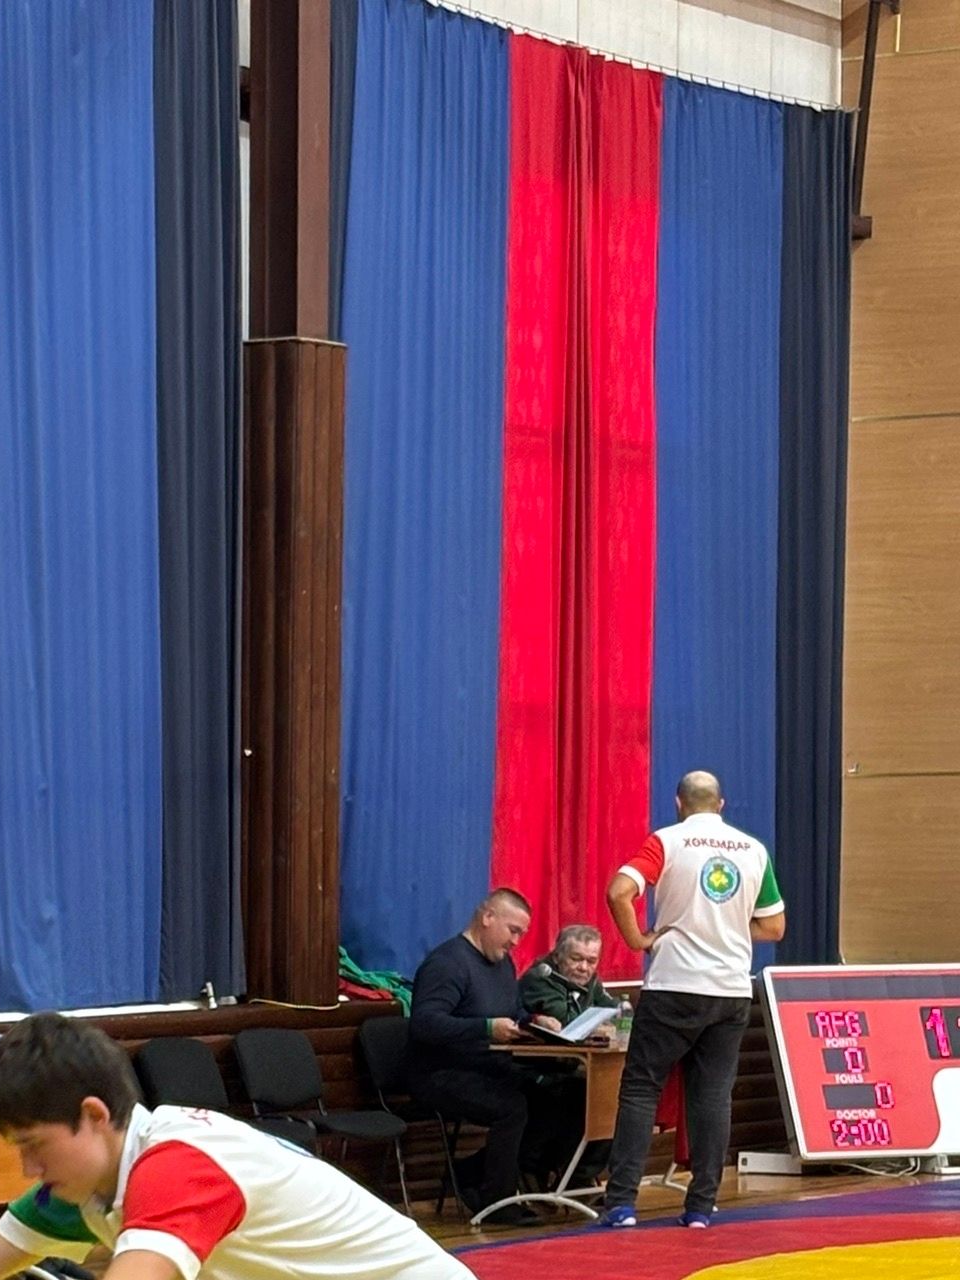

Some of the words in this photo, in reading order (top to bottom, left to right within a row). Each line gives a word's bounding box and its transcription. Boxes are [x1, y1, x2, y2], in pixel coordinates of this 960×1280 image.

[825, 1038, 858, 1048] POINTS
[926, 1008, 960, 1057] 1
[844, 1048, 864, 1073] 0
[835, 1074, 864, 1084] FOULS
[874, 1083, 895, 1108] 0
[836, 1110, 876, 1119] DOCTOR
[832, 1119, 890, 1146] 2:00
